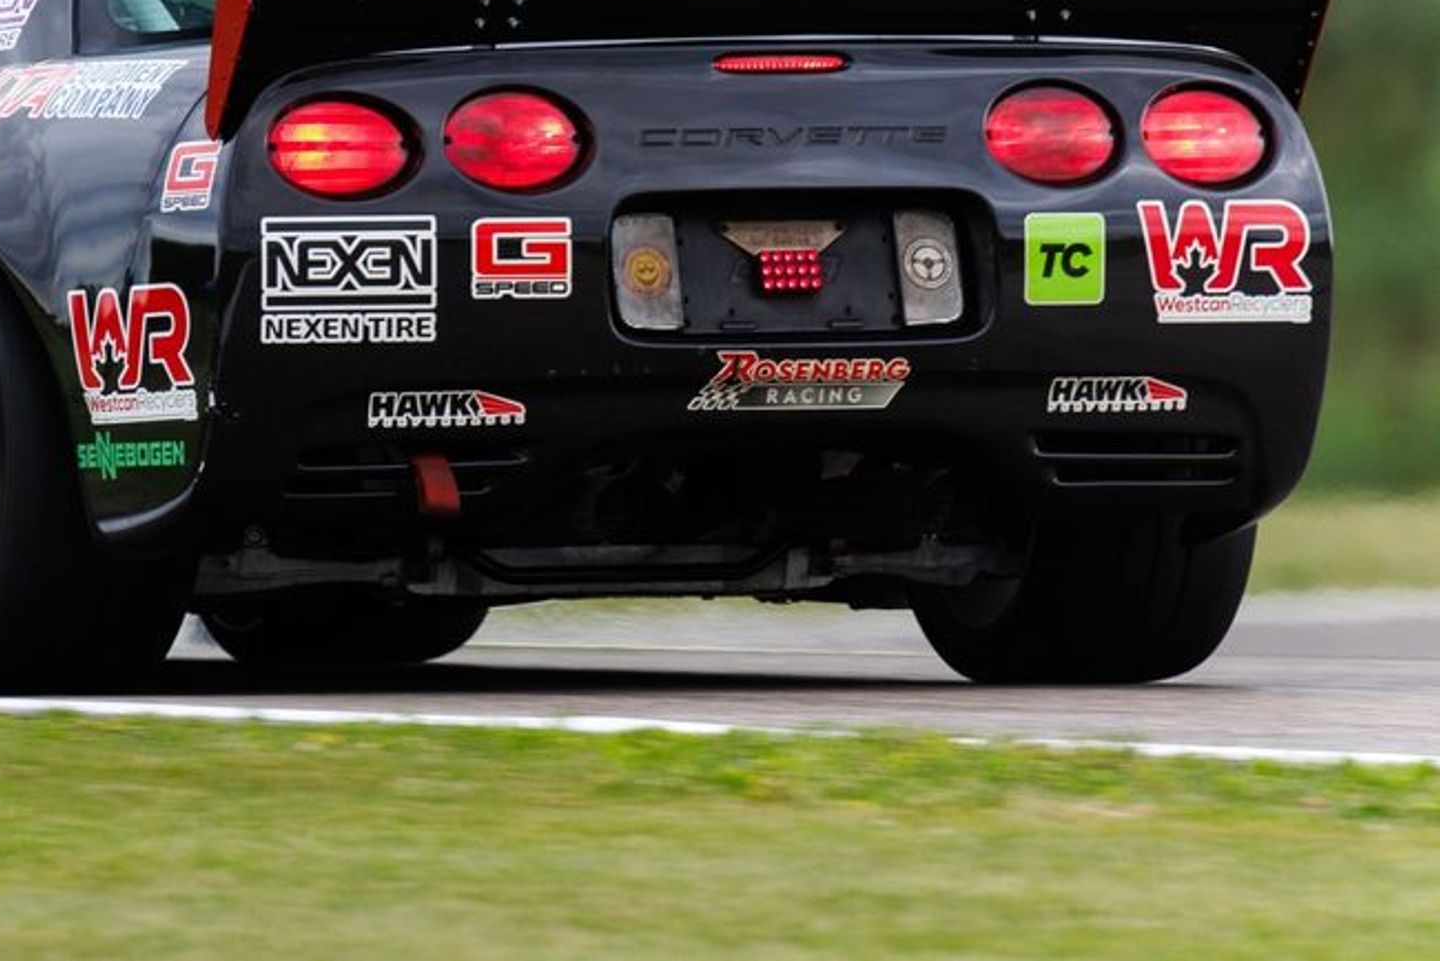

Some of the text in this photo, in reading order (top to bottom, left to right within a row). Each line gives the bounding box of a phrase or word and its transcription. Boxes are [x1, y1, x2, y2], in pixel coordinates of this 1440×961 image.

[45, 84, 162, 118] COMPANY
[640, 125, 947, 147] CORVETTE
[164, 141, 221, 193] G
[263, 234, 435, 292] NEXEN
[473, 218, 571, 278] G
[1039, 242, 1093, 278] TC
[473, 280, 570, 296] SPEED
[264, 315, 435, 341] NEXEN TIRE
[712, 350, 910, 383] ROSENBERG
[369, 392, 474, 418] HAWK
[765, 387, 863, 404] RACING
[1049, 377, 1145, 402] HAWK
[76, 431, 185, 480] SENNEBOGEN
